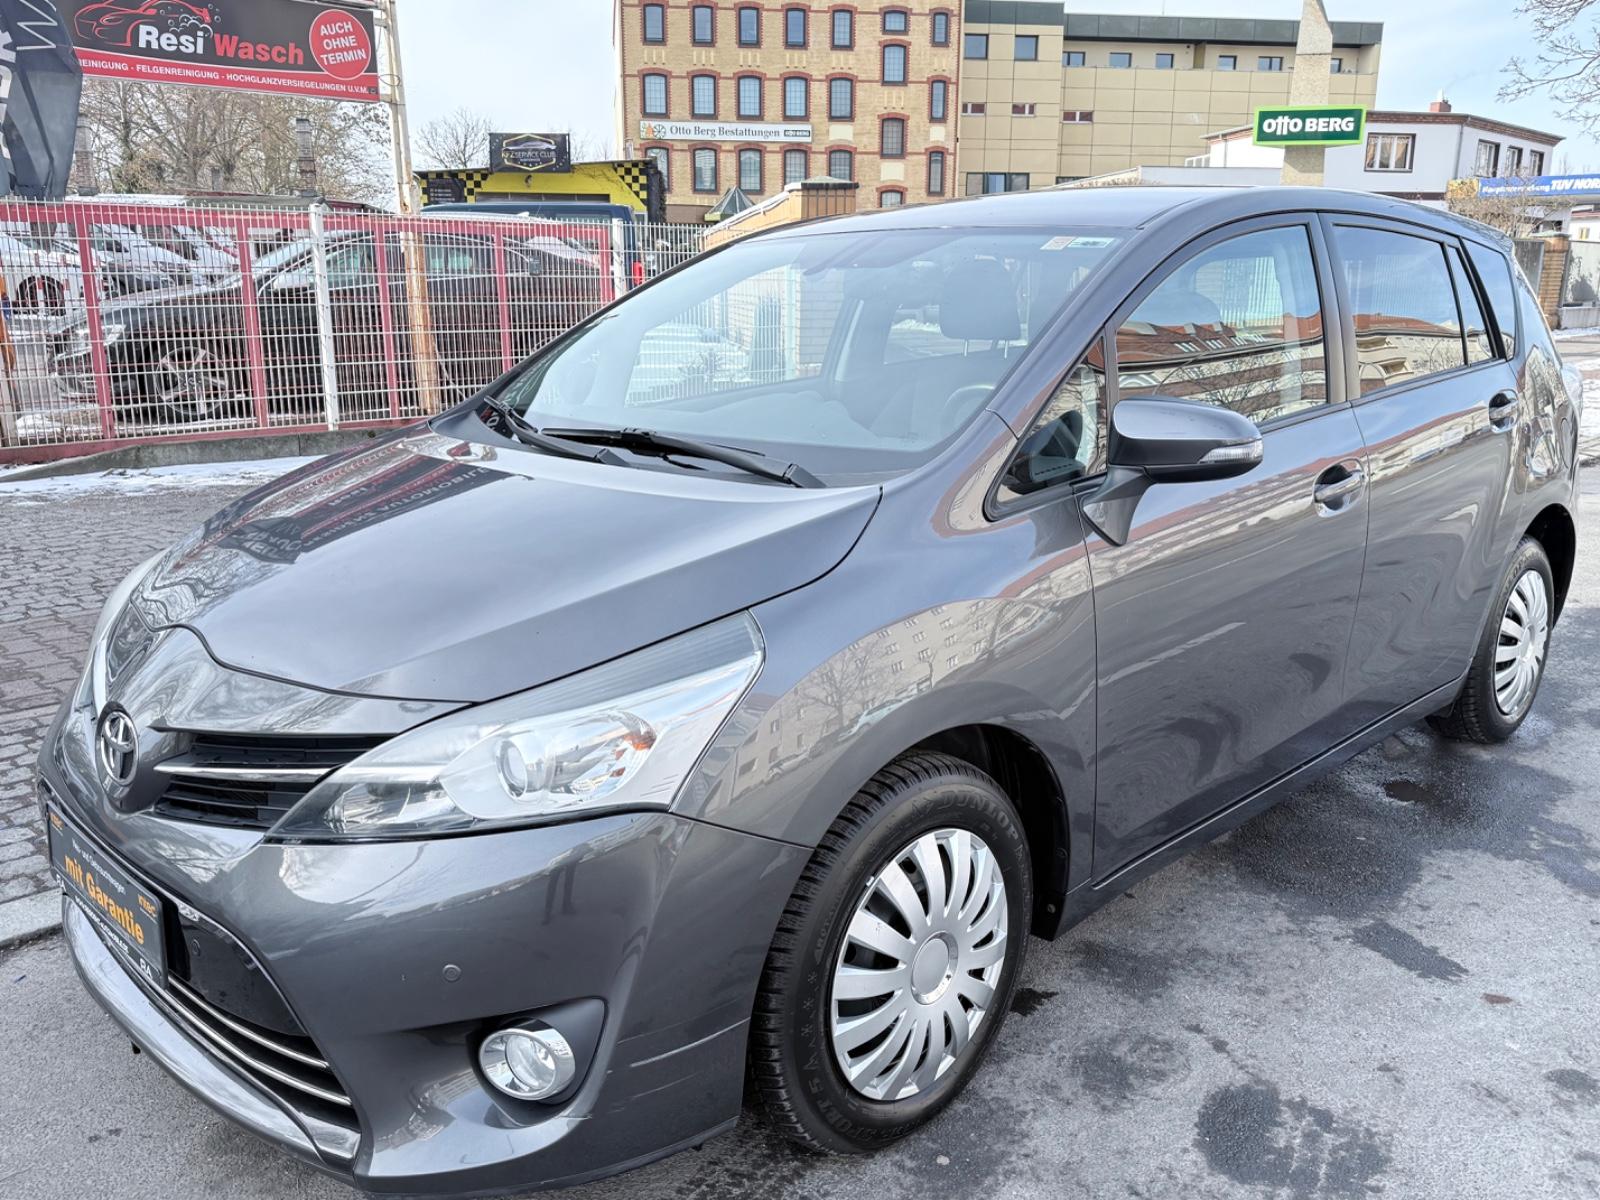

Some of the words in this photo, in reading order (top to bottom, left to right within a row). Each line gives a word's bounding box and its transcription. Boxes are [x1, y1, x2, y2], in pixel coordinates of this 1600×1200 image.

[320, 22, 353, 36] AUCH
[138, 25, 204, 54] Resi
[213, 33, 304, 65] Wasch
[323, 35, 358, 50] OHNE
[320, 49, 367, 65] TERMIN
[136, 64, 220, 79] FELGENREINIGUNG
[226, 73, 346, 92] HOCHGLANZVERSIEGELUNGEN
[1305, 117, 1355, 131] BERG
[670, 125, 691, 136] Otto
[694, 126, 716, 138] Berg
[718, 126, 780, 139] Bestattungen
[65, 854, 84, 889] mit
[86, 871, 145, 945] Garantie
